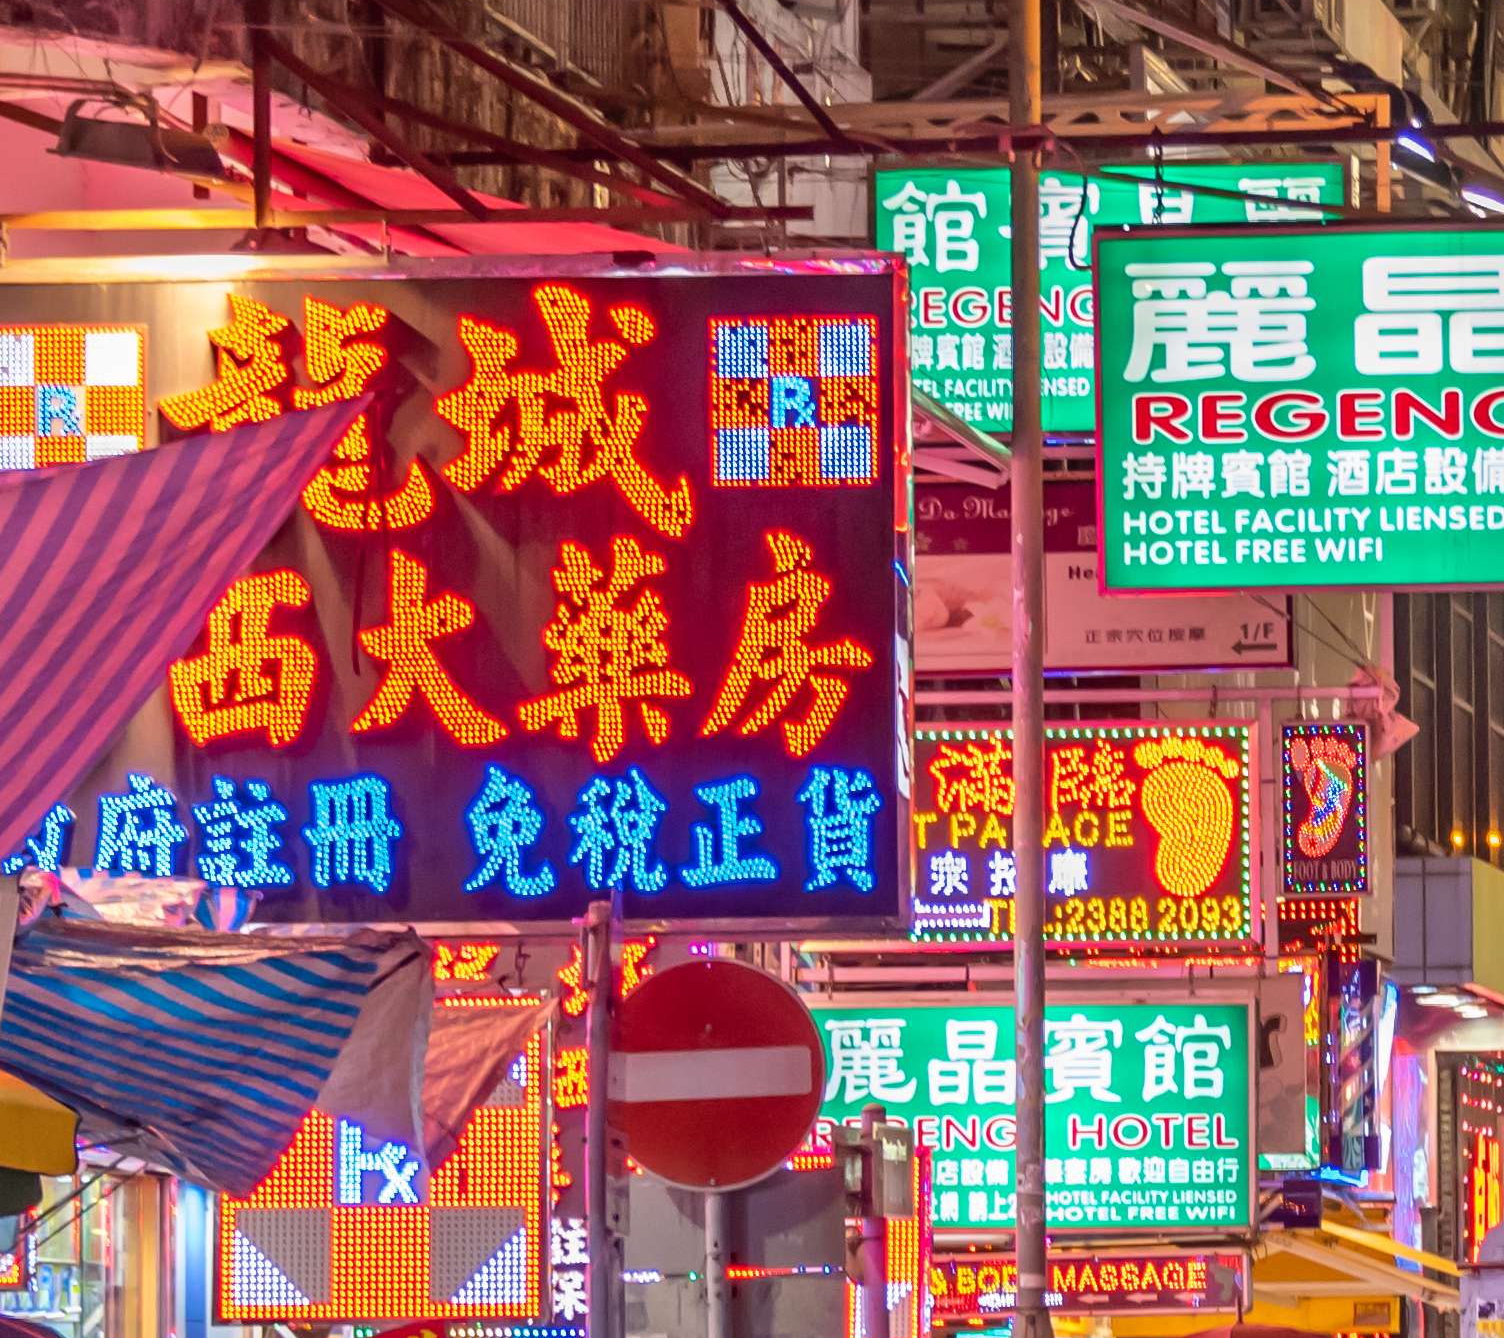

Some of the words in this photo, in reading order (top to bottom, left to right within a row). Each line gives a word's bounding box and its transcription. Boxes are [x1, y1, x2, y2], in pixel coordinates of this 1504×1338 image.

[1122, 447, 1312, 501] 持牌賓館
[1123, 507, 1229, 536] HOTEL
[1234, 506, 1373, 534] FACILITY
[1123, 539, 1230, 565] HOTEL
[1234, 538, 1307, 564] FREE
[1312, 537, 1384, 563] WIFI
[1240, 623, 1275, 640] 1/F
[1158, 897, 1242, 933] 2093
[1067, 1113, 1239, 1150] HOTEL
[1100, 1191, 1169, 1205] FACILITY
[1171, 1190, 1237, 1204] LIENSED
[1127, 1206, 1180, 1221] FREE
[1186, 1206, 1236, 1220] WIFI
[1053, 1263, 1206, 1292] MASSAGE
